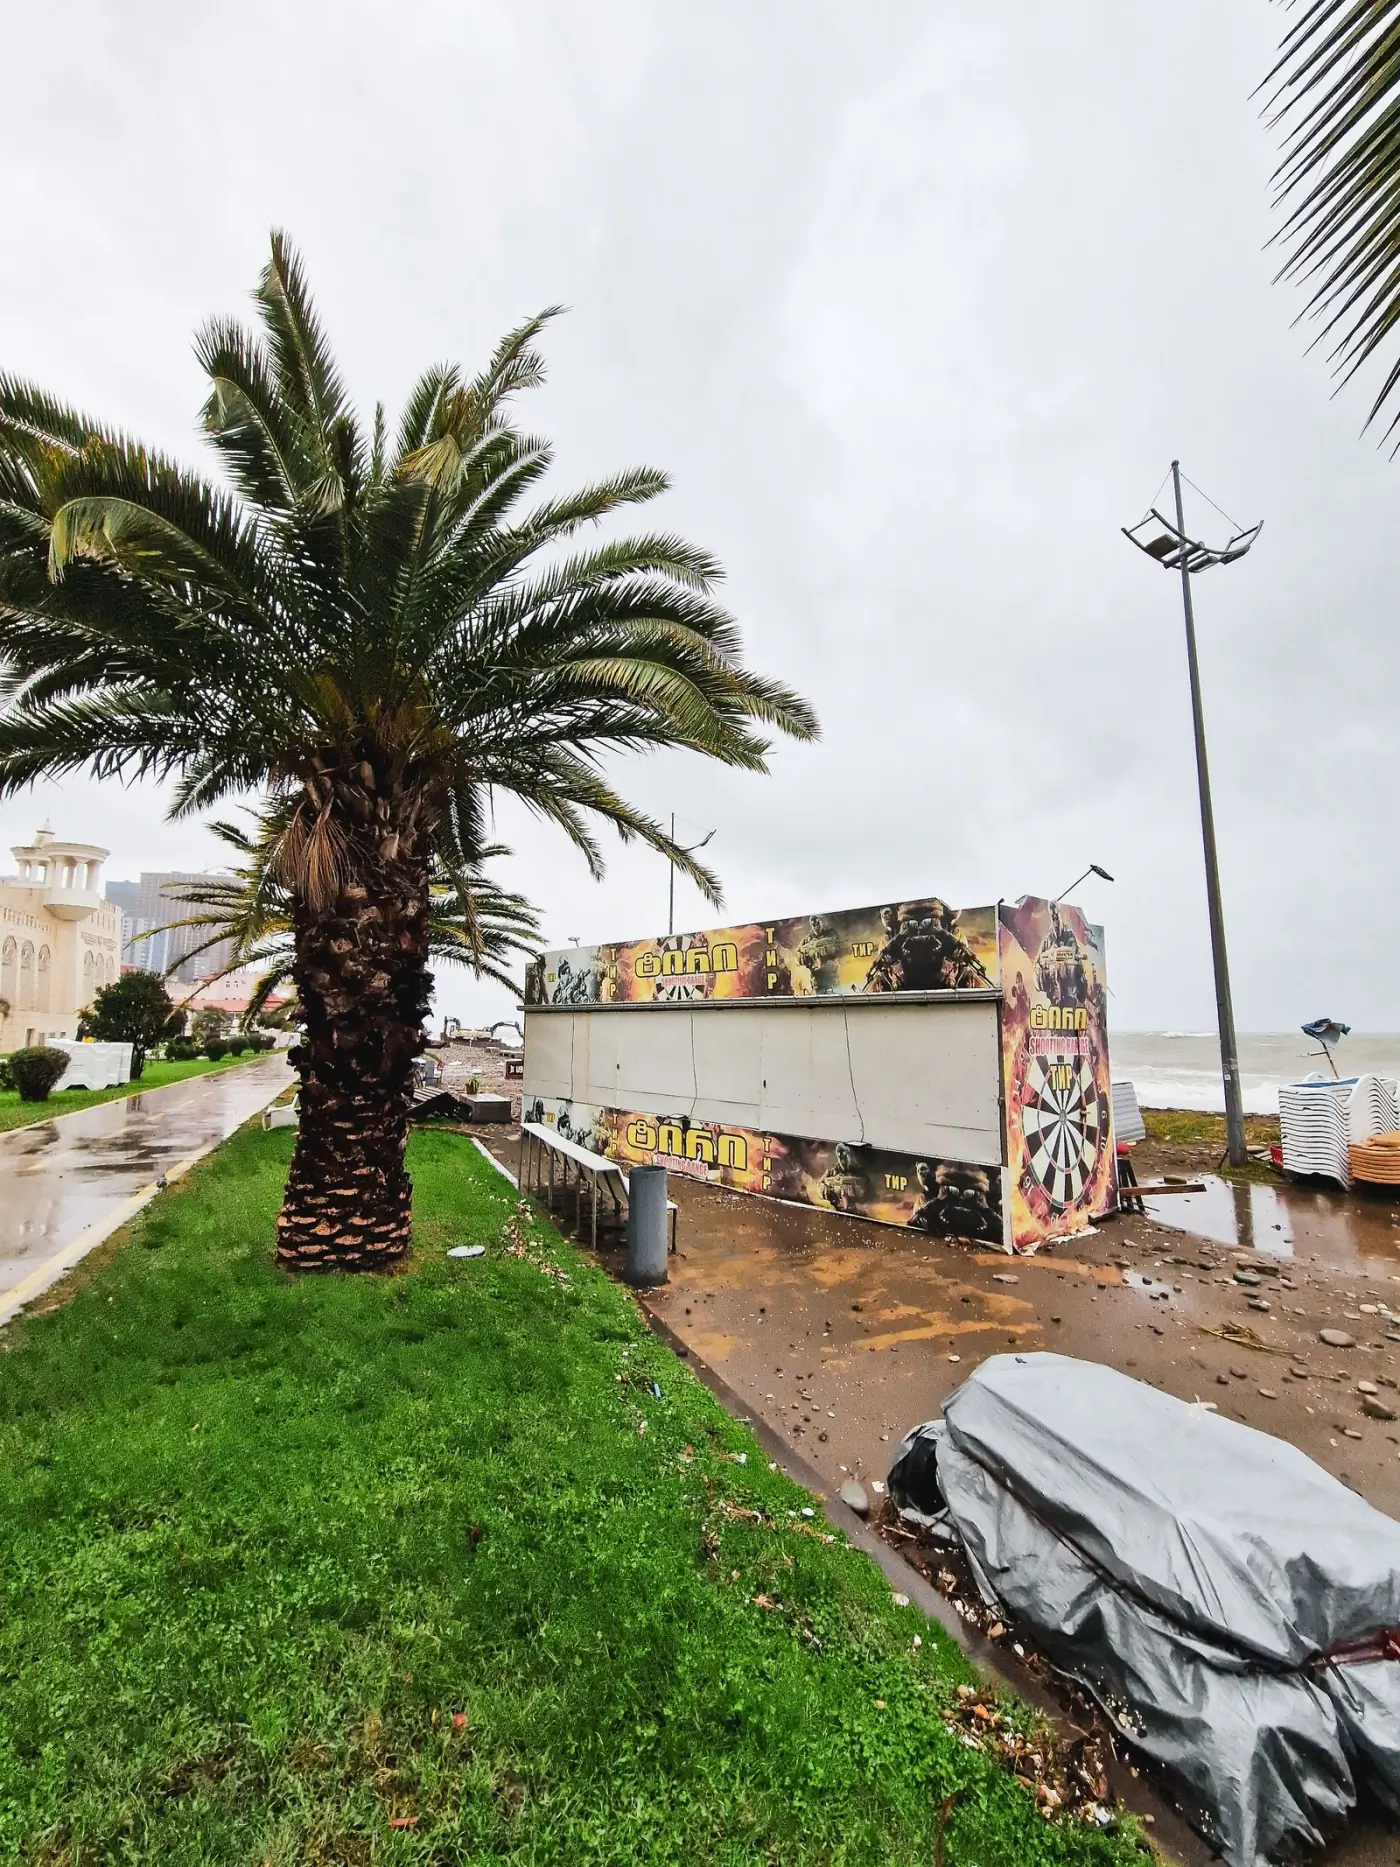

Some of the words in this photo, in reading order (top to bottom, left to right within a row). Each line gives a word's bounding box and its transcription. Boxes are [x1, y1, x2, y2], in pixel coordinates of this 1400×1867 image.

[765, 926, 778, 990] ТИР
[852, 942, 875, 958] ТИР
[608, 948, 618, 997] ТИР
[1030, 1037, 1066, 1055] SHOOTING
[1049, 1063, 1074, 1091] ТИР
[762, 1136, 773, 1191] ТИР
[884, 1173, 908, 1191] ТИР
